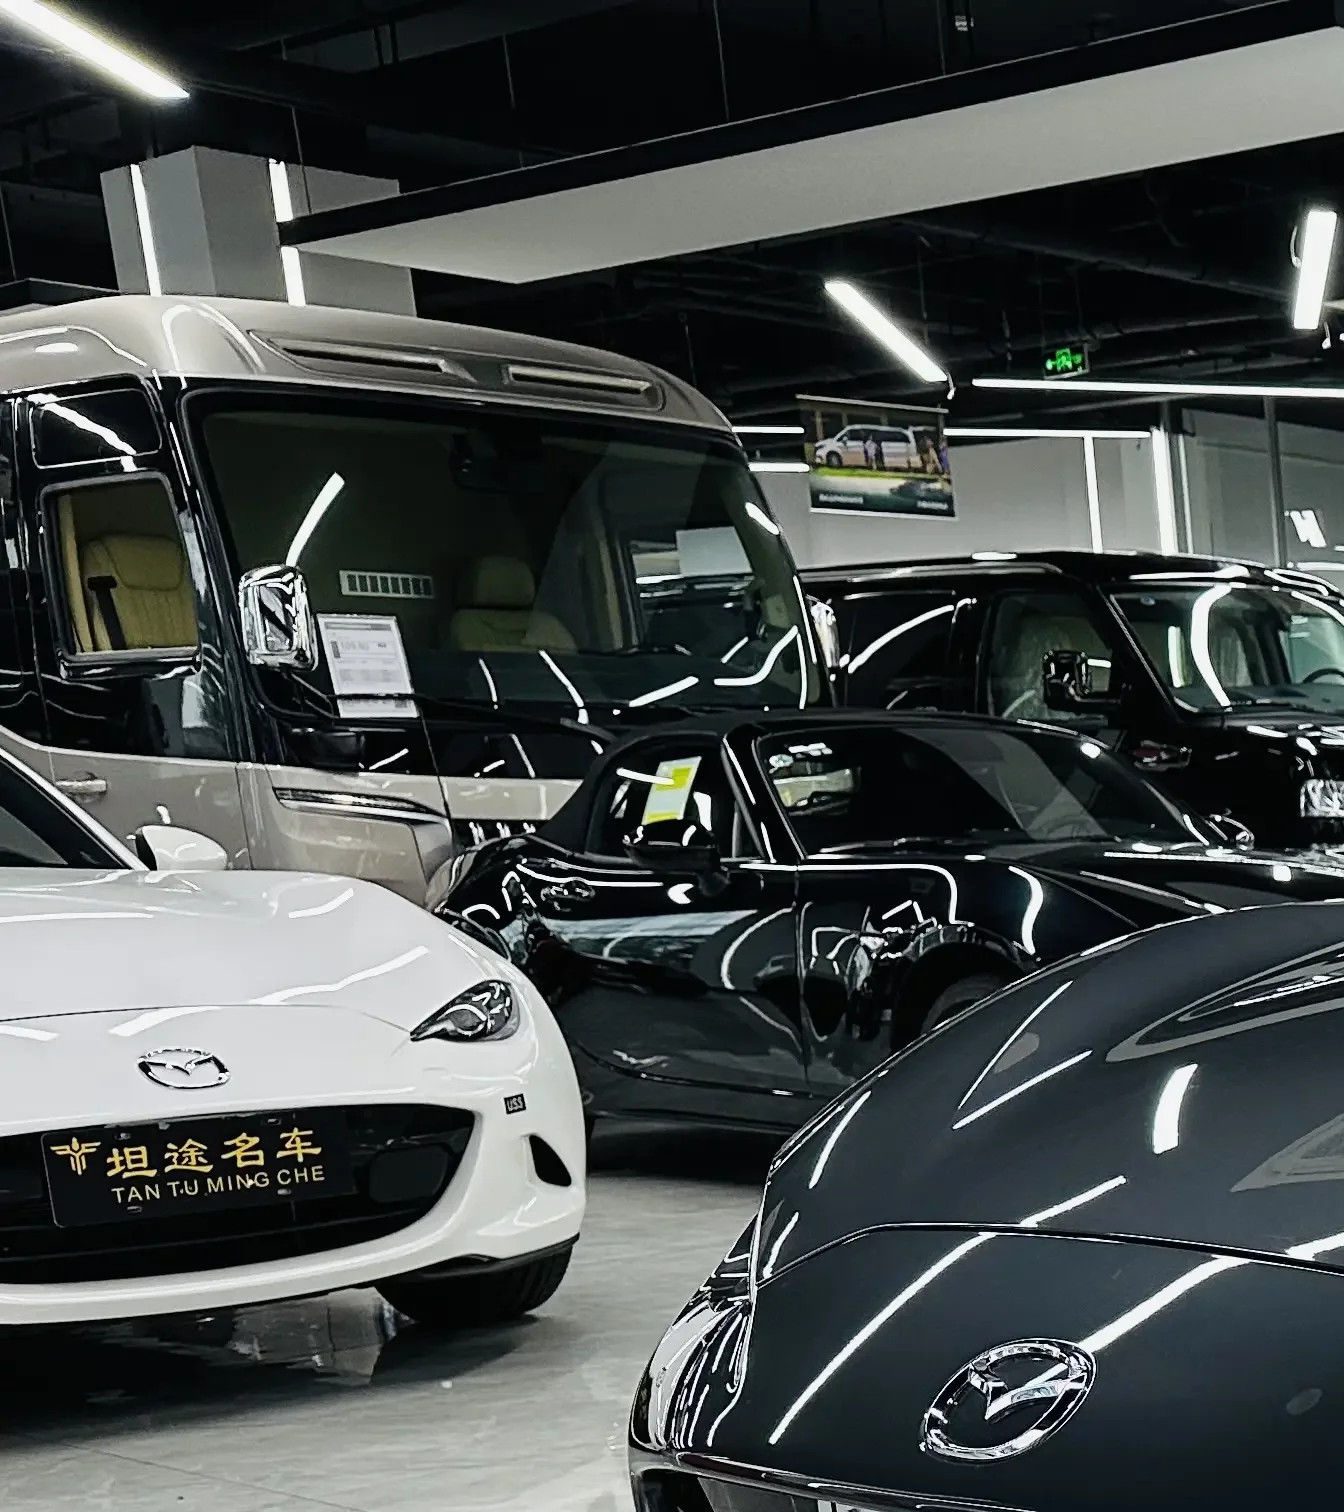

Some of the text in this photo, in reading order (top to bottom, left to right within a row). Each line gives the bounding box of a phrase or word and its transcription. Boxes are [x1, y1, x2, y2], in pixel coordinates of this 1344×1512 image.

[106, 1126, 322, 1180] 坦途名车
[111, 1183, 161, 1205] TAN
[207, 1171, 271, 1194] MING
[277, 1165, 326, 1187] CHE
